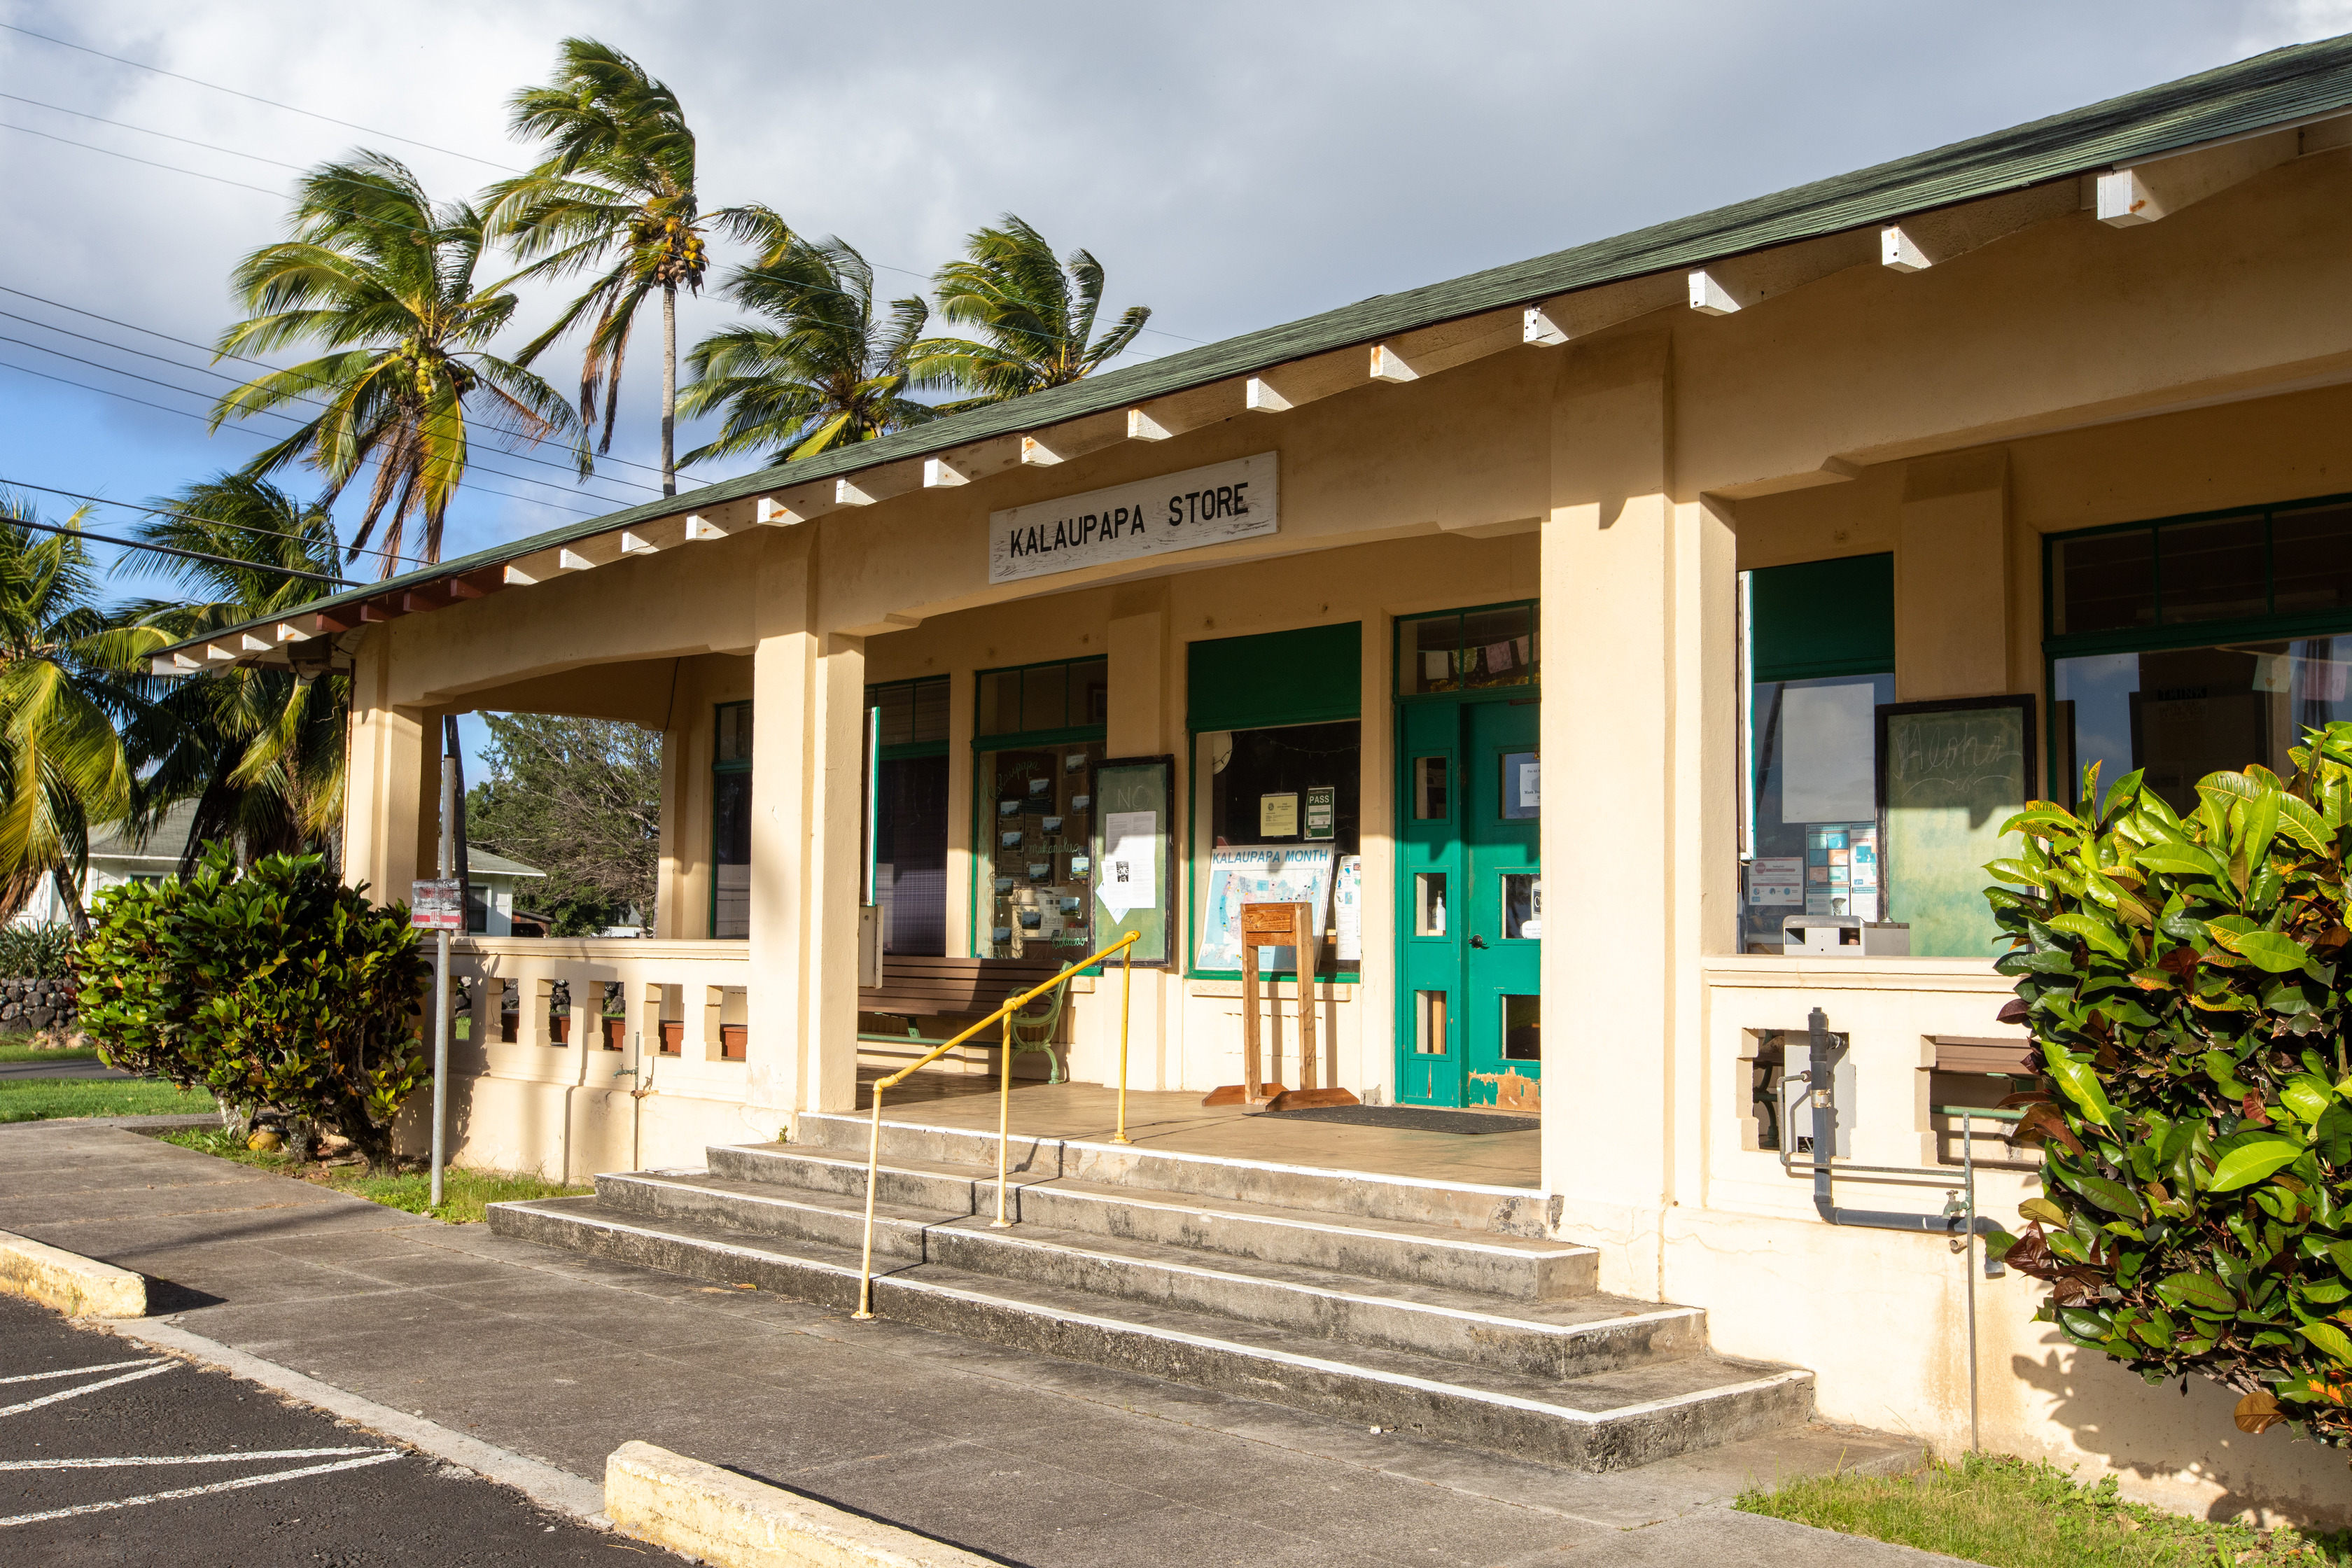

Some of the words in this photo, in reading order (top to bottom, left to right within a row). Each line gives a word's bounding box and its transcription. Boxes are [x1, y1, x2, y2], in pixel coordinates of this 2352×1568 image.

[1010, 504, 1145, 558] KALAUPAPA
[1168, 482, 1249, 526] STORE
[2162, 687, 2204, 700] THINK
[1893, 722, 2022, 780] Aloha
[1117, 785, 1149, 810] NO
[1310, 794, 1329, 804] PASS
[1212, 850, 1280, 864] KALAUPAPA
[1284, 849, 1328, 862] MONTH
